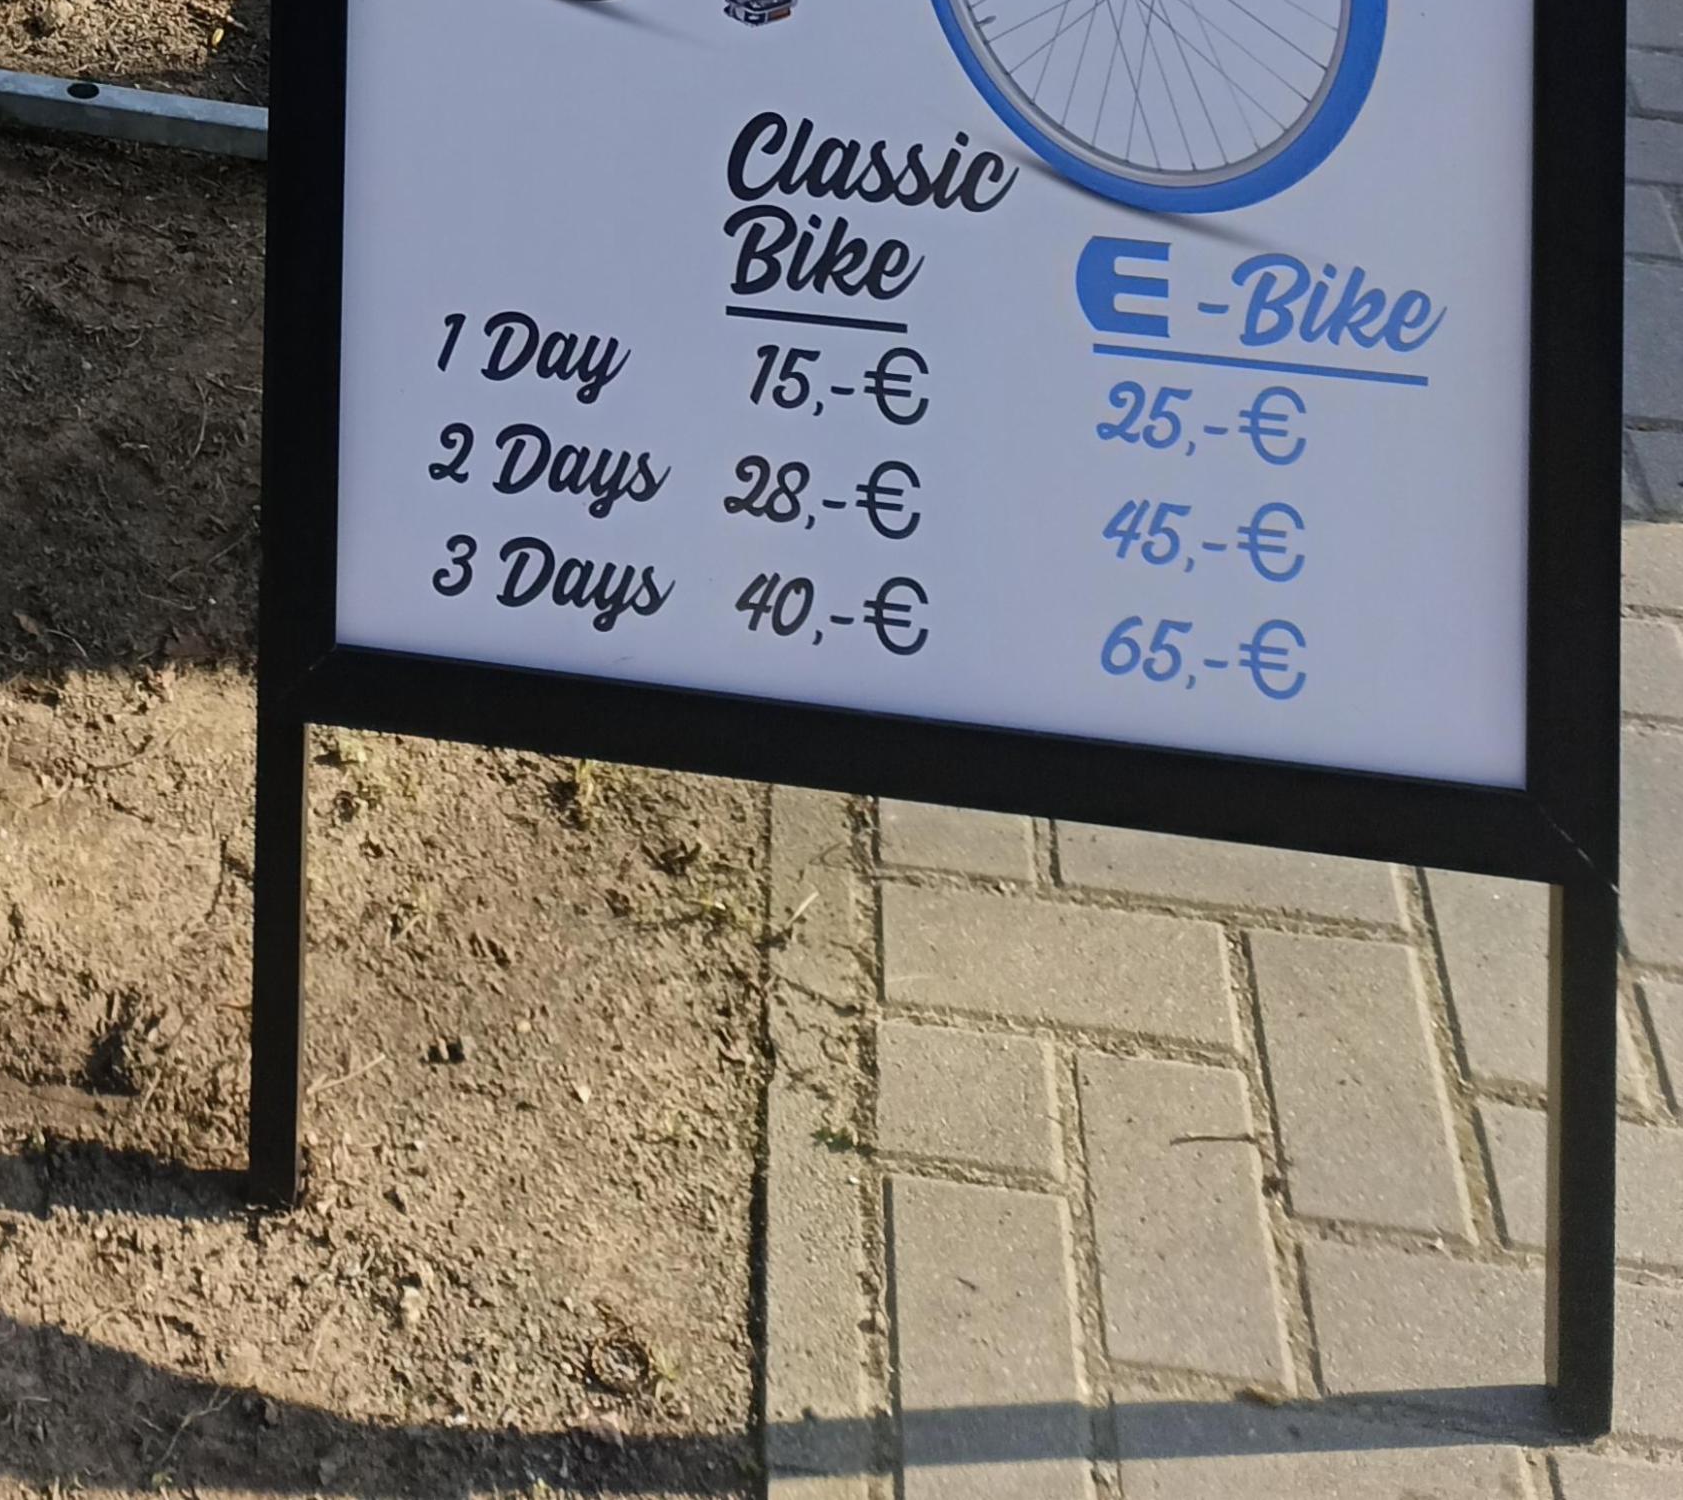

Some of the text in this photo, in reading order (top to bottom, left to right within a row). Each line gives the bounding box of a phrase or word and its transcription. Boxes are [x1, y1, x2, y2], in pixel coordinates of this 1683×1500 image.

[725, 111, 1019, 214] Classic
[723, 203, 925, 301] Bike
[437, 313, 467, 372] 1
[480, 311, 632, 405] Day
[428, 422, 474, 484] 2
[491, 423, 672, 519] Days
[432, 534, 478, 597] 3
[496, 536, 676, 632] Days
